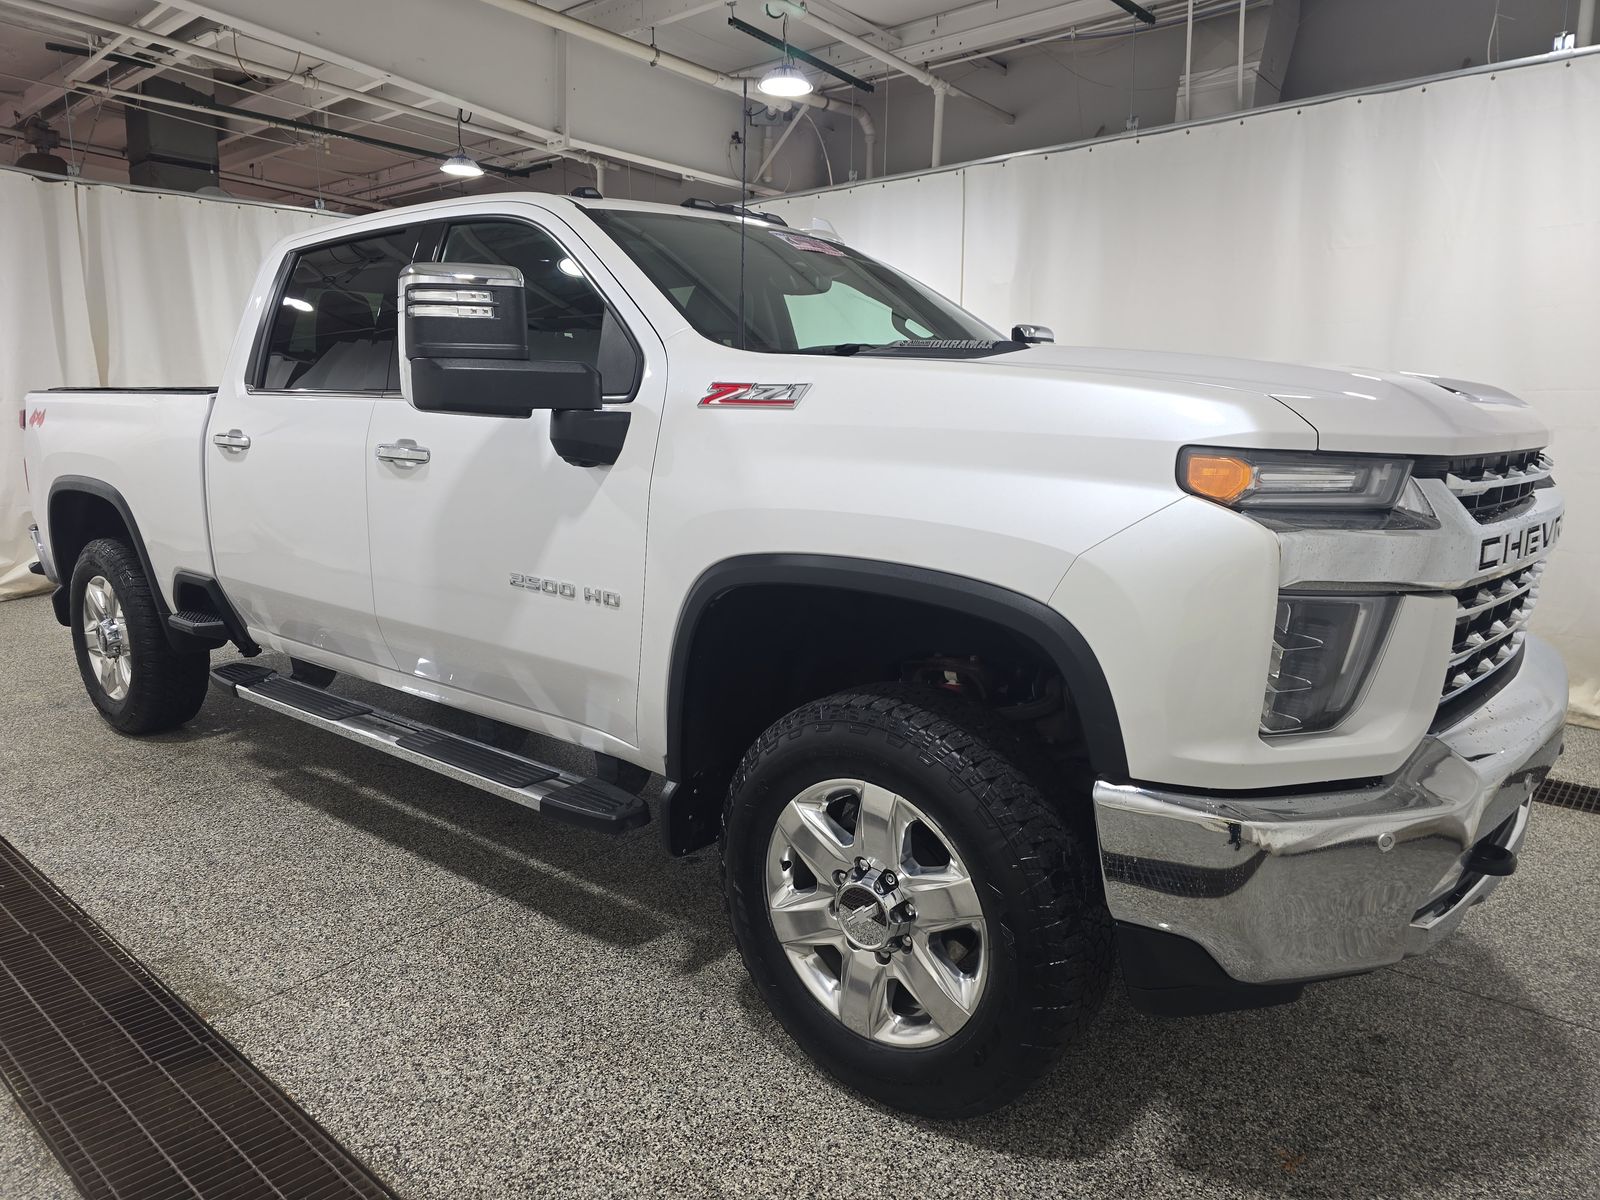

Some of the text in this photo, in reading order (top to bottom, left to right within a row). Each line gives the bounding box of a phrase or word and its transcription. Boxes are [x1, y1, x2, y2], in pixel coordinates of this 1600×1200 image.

[930, 339, 996, 350] DURAMAX
[697, 382, 813, 410] Z71
[509, 572, 622, 608] 2500 HD
